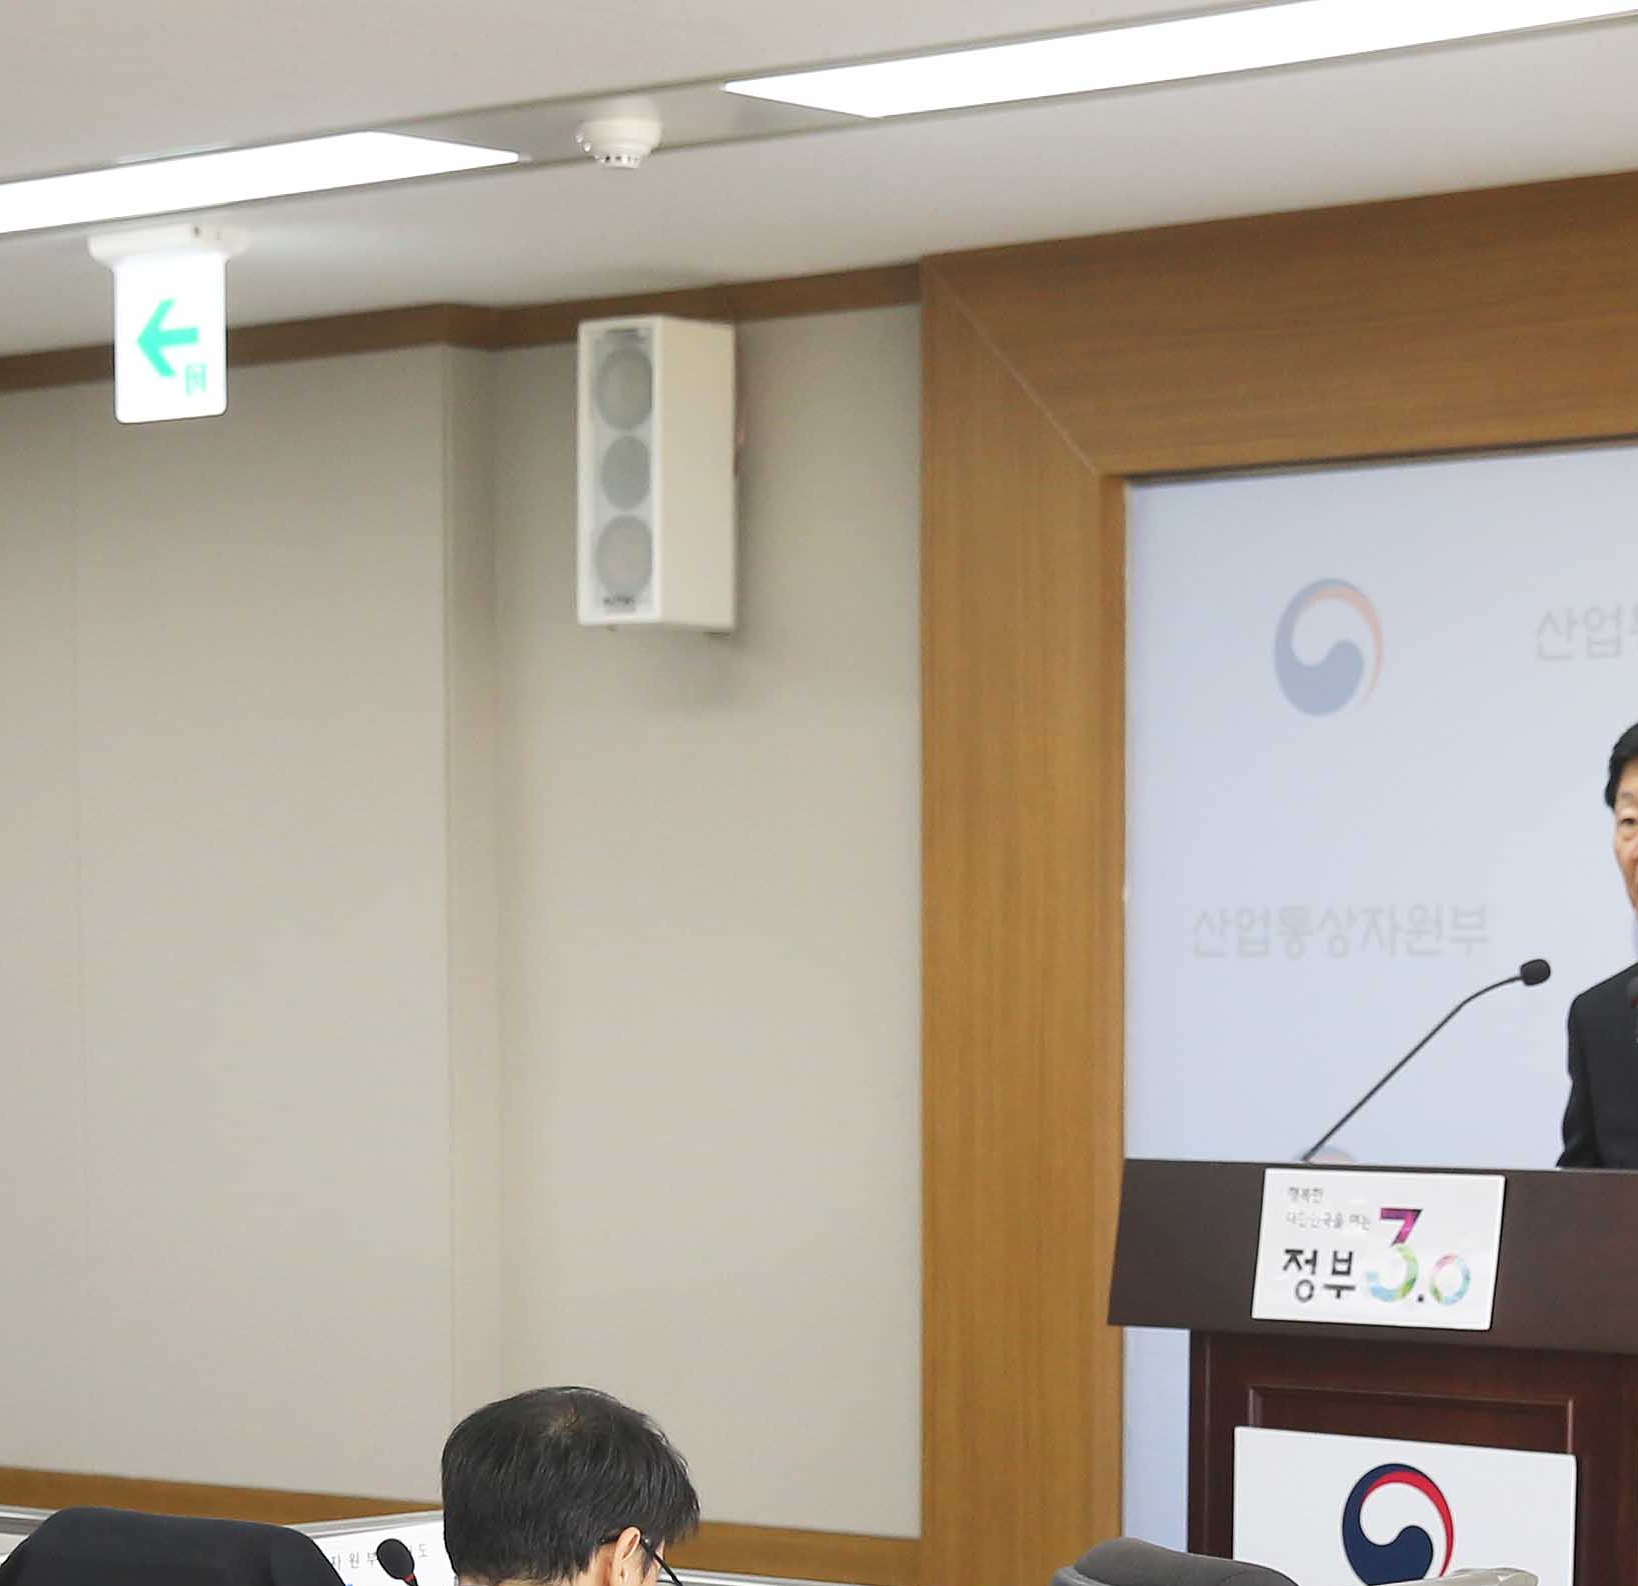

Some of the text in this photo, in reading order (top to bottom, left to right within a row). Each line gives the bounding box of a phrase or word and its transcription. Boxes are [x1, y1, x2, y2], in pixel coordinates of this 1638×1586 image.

[1192, 902, 1490, 960] 산업통상자원부
[1282, 1207, 1472, 1306] 정부 3.0
